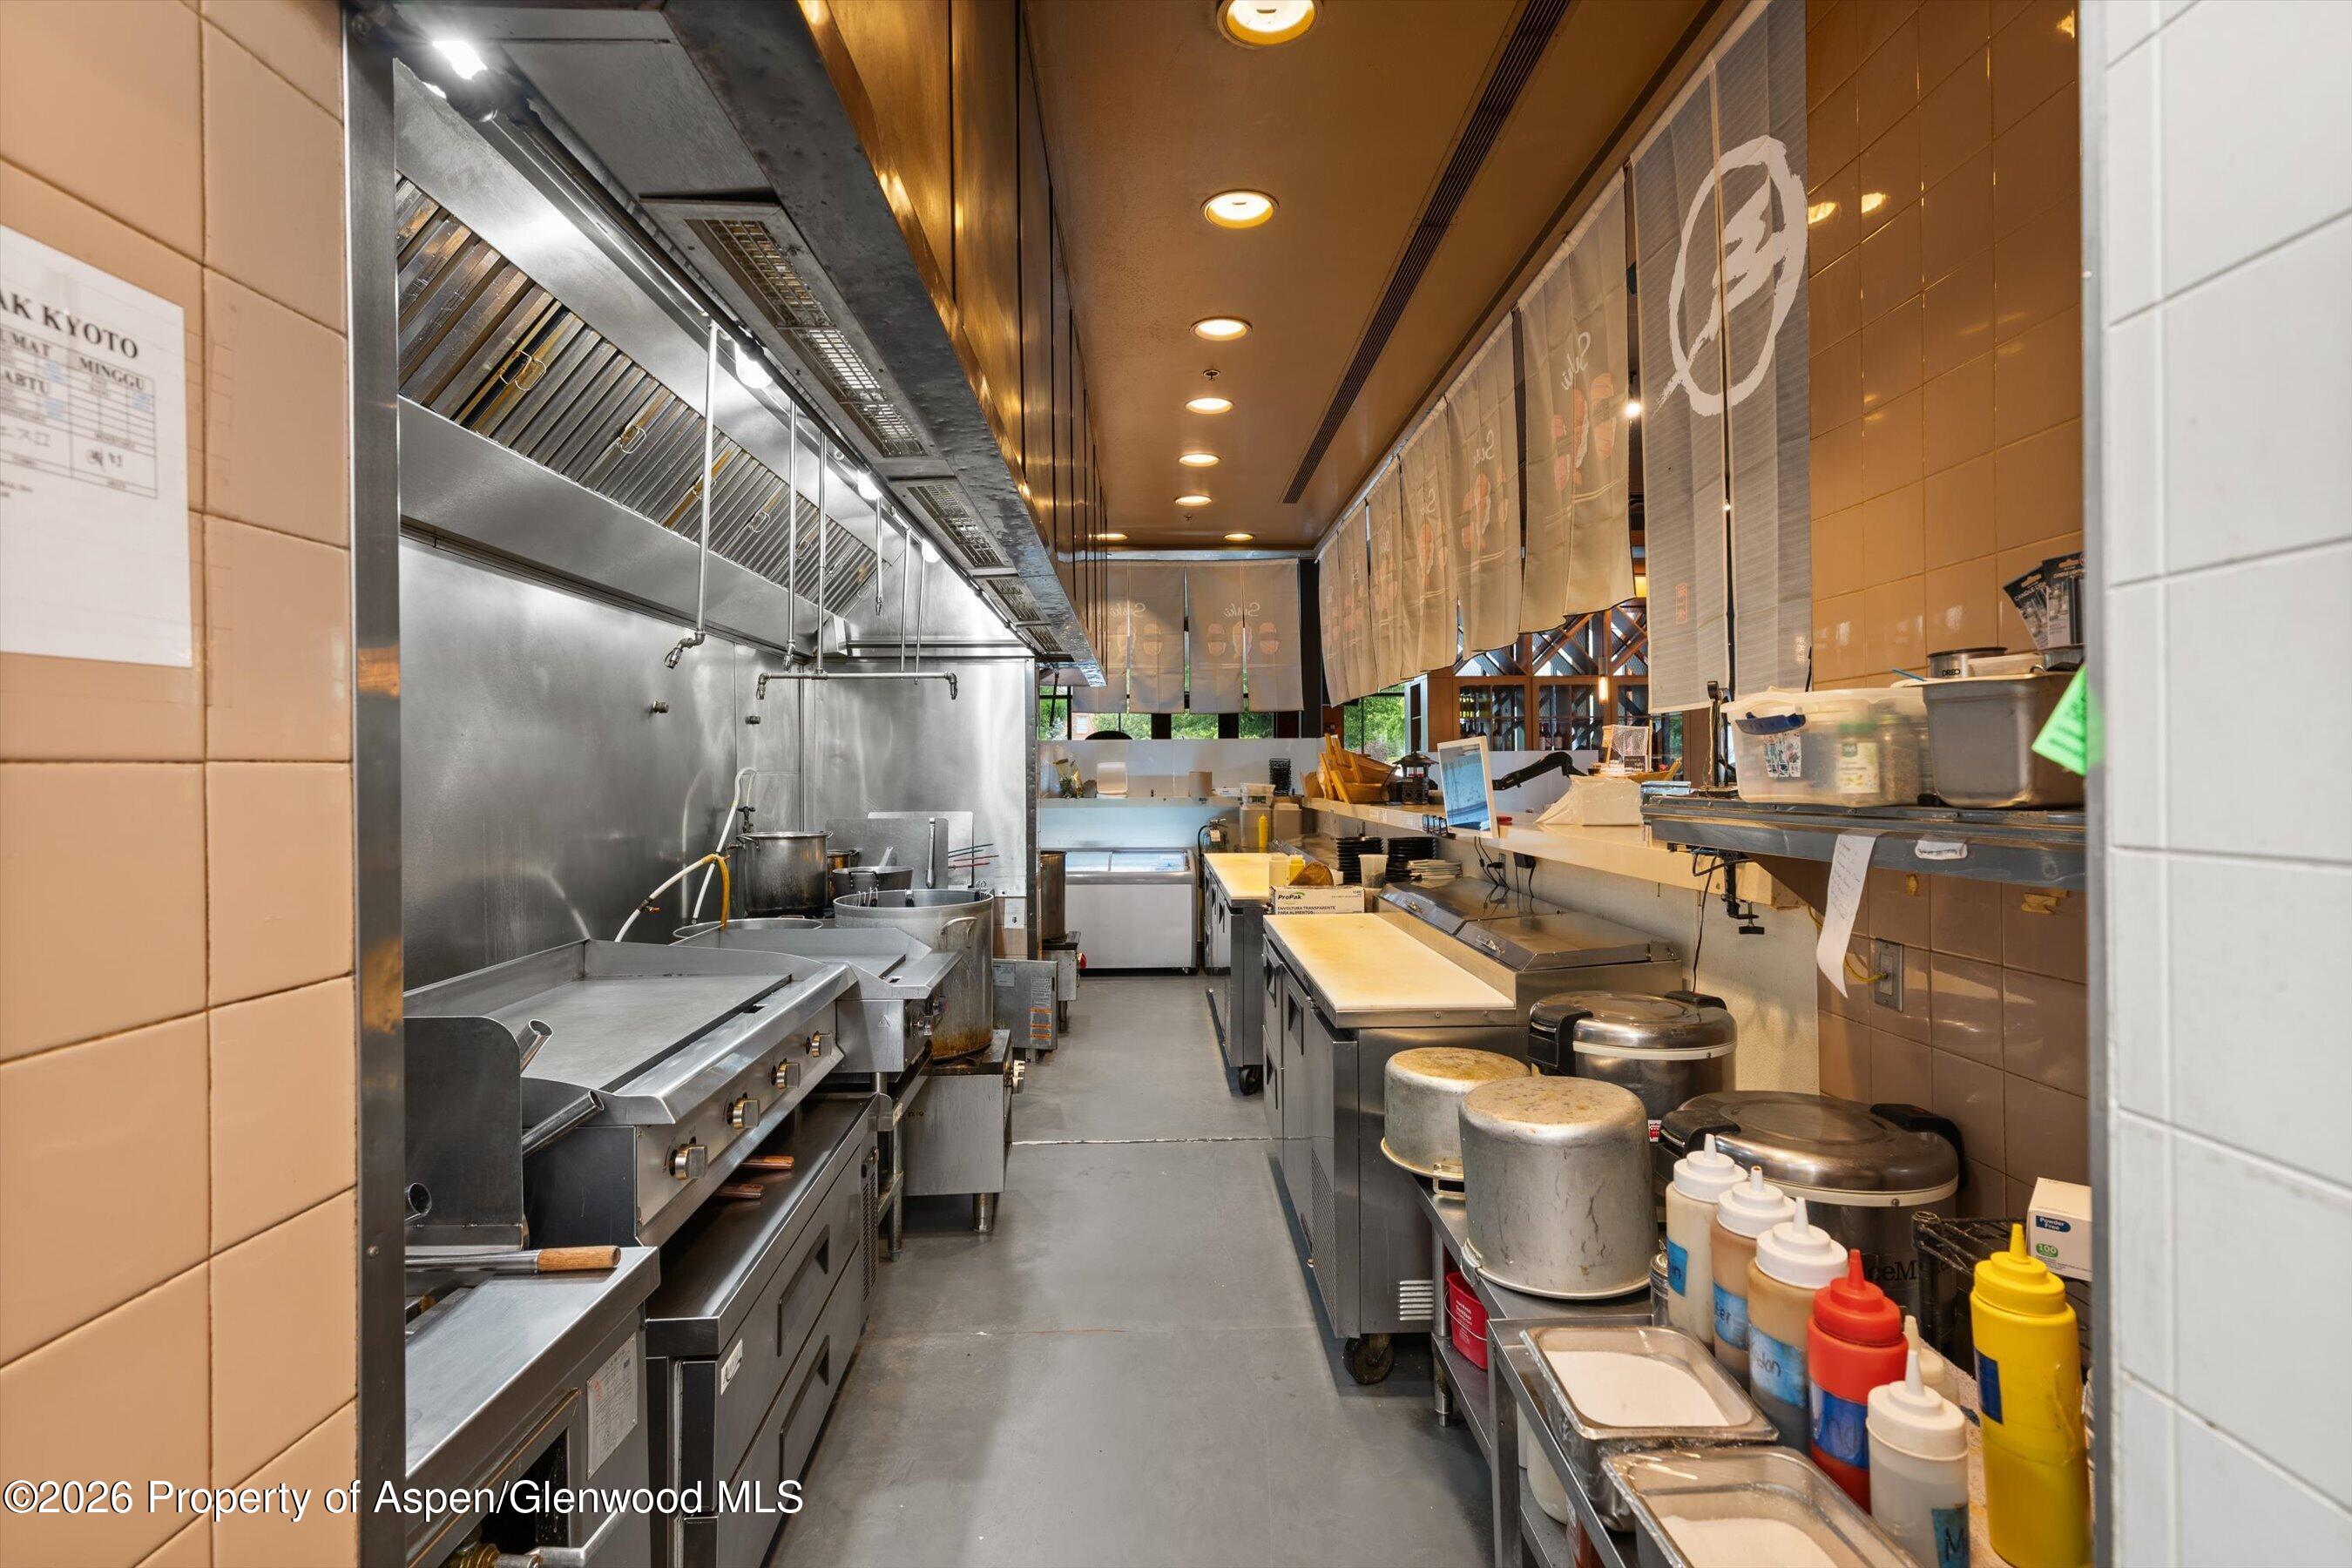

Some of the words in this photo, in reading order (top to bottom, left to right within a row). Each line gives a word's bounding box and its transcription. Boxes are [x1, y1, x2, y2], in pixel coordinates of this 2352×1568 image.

[43, 305, 138, 359] KYOTO
[79, 357, 144, 390] MINGGU
[2038, 1244, 2057, 1254] 100
